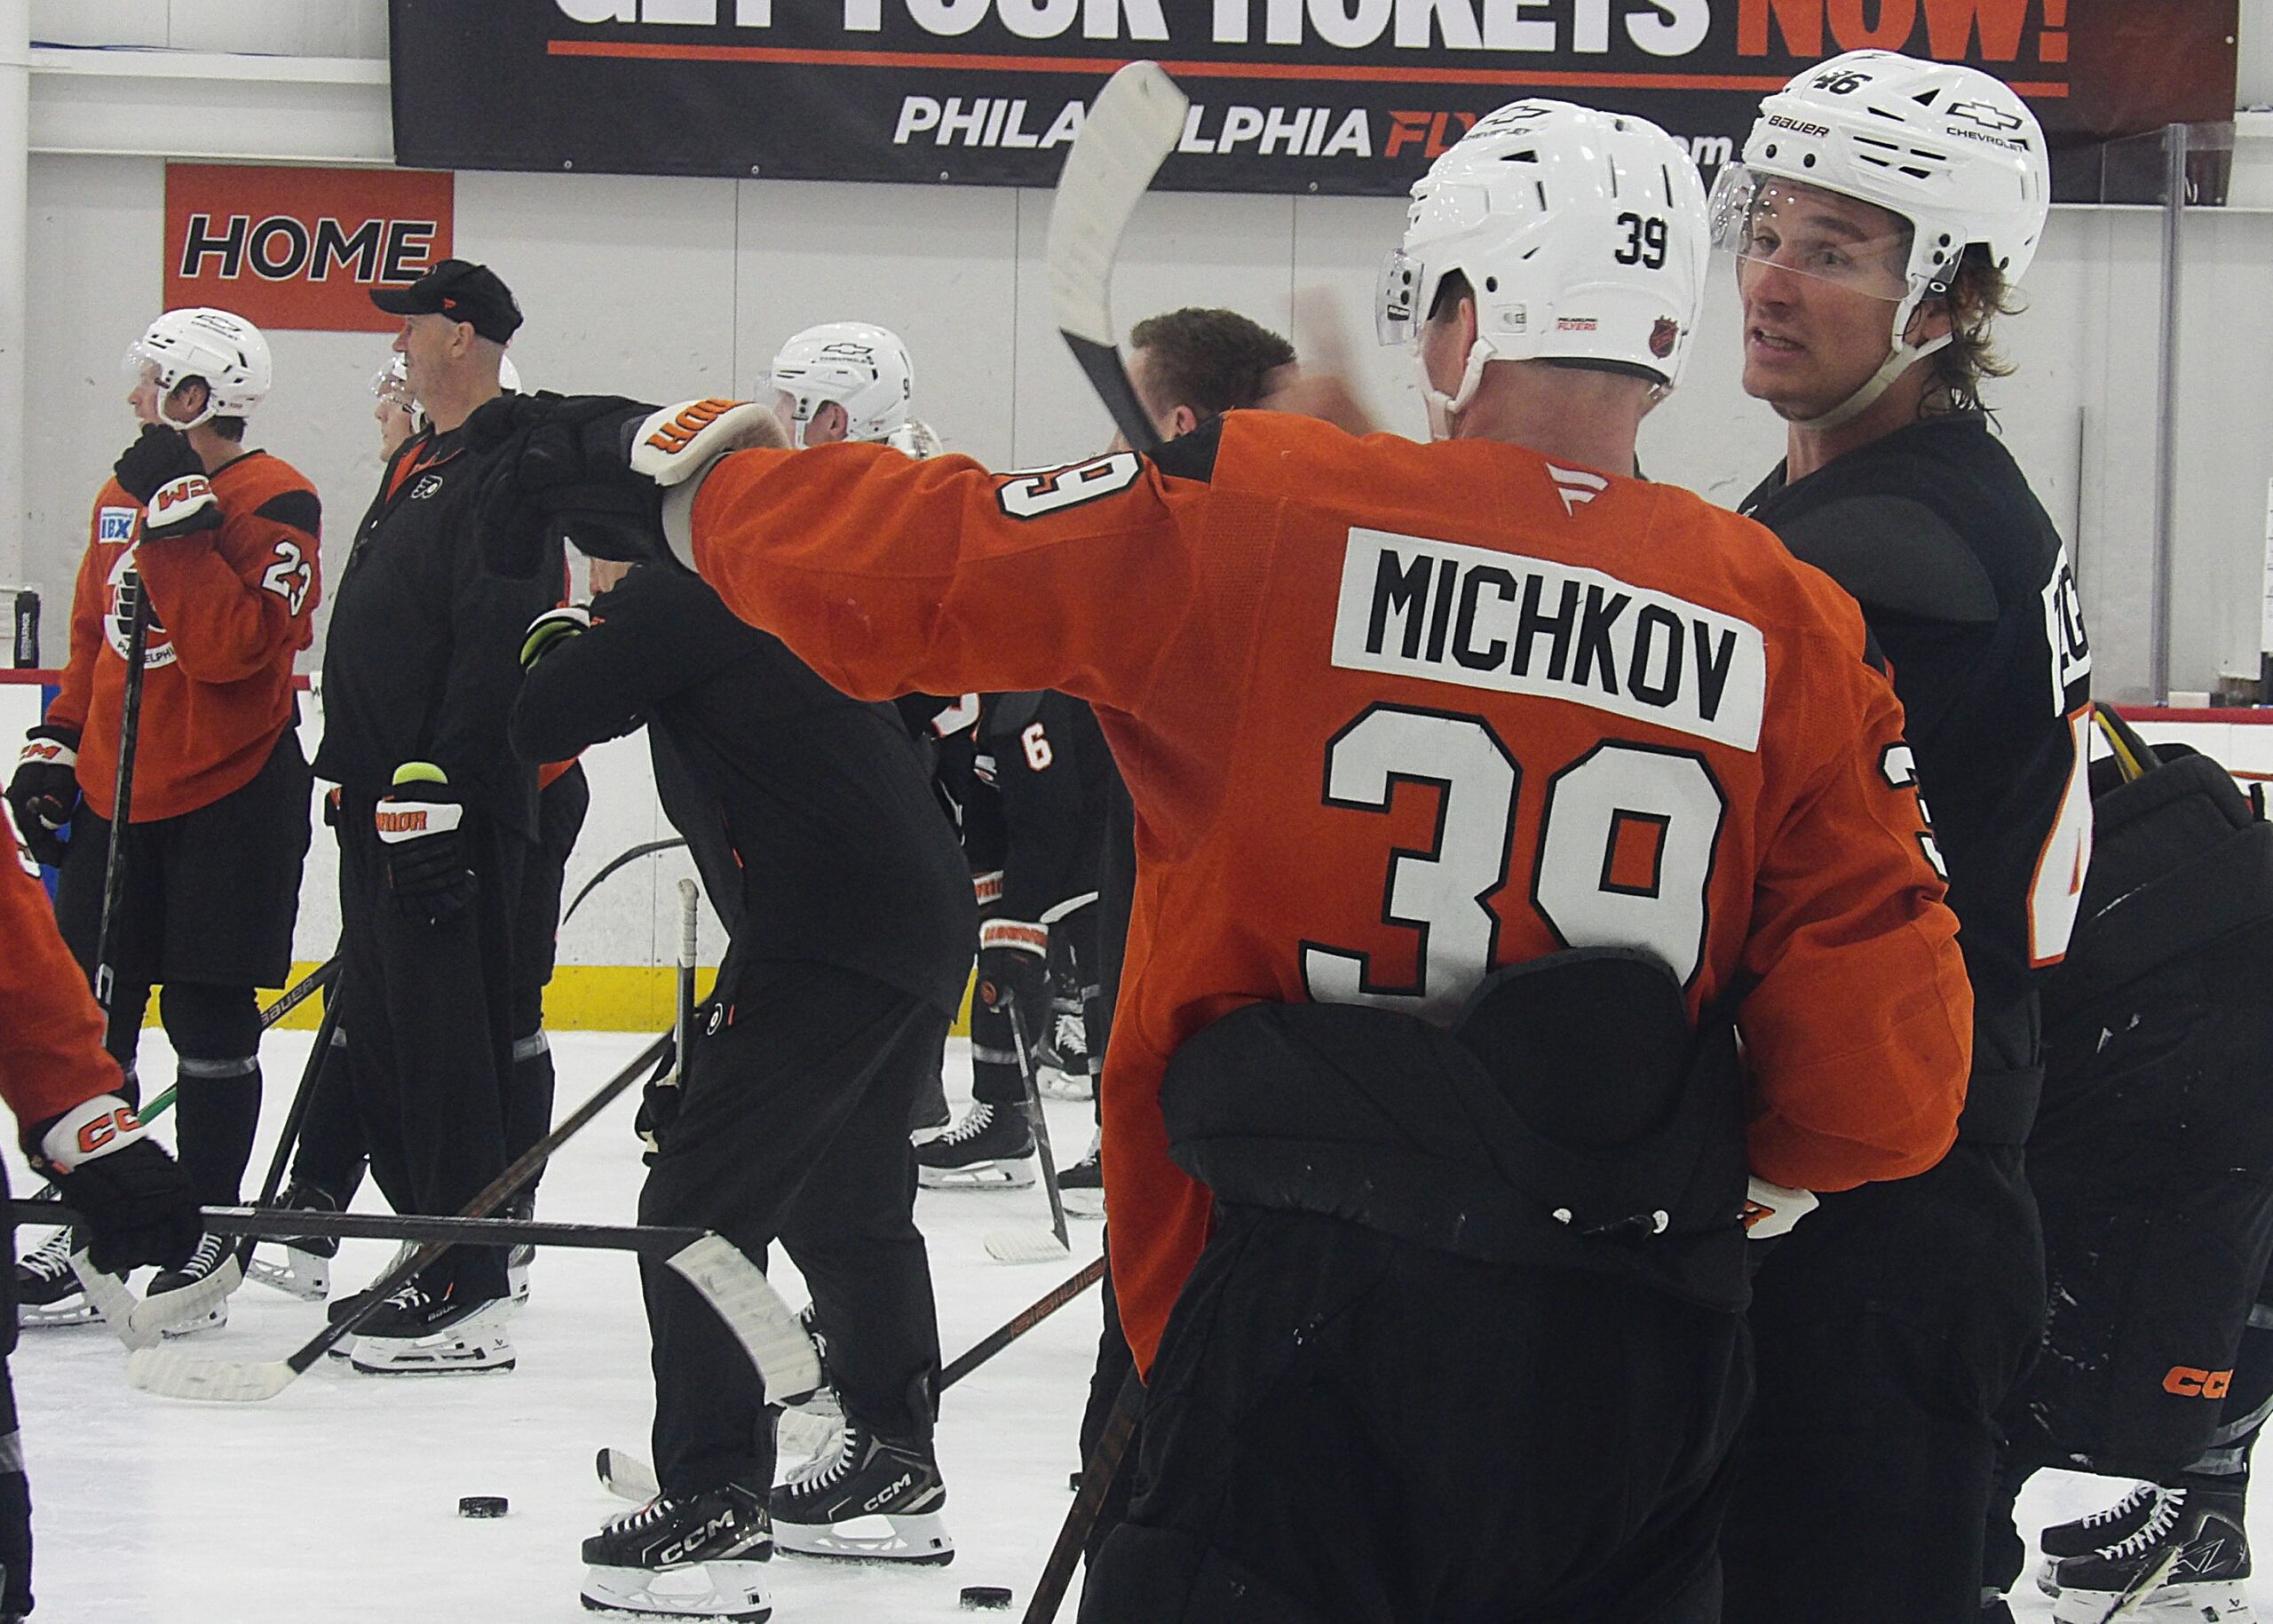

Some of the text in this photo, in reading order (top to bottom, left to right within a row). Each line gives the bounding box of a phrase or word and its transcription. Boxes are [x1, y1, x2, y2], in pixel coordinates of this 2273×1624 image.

[893, 95, 1373, 158] PHILALPHIA
[1768, 115, 1832, 139] BAUER
[1946, 127, 2024, 153] CHEVROLET
[180, 214, 438, 285] HOME
[1615, 211, 1668, 270] 39
[100, 517, 133, 539] IBX
[262, 538, 313, 618] 23
[1364, 548, 1738, 724] MICHKOV
[1020, 720, 1054, 772] 6
[1298, 700, 1730, 1030] 39
[77, 1106, 143, 1153] CC
[863, 1473, 913, 1513] CCM
[660, 1509, 735, 1565] CCM
